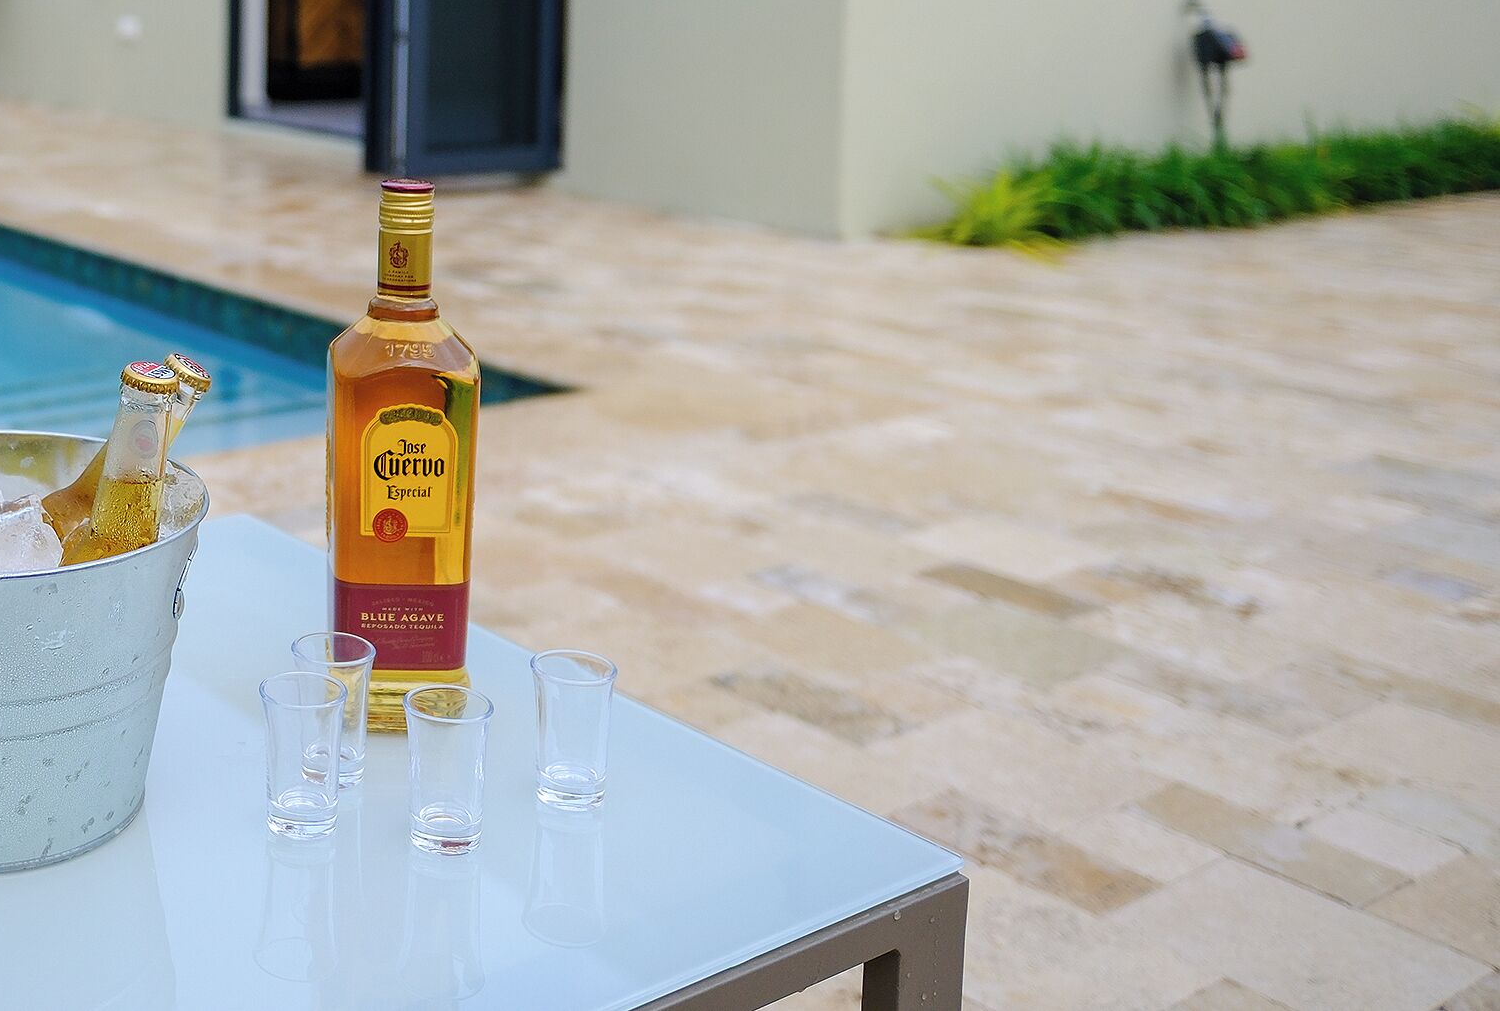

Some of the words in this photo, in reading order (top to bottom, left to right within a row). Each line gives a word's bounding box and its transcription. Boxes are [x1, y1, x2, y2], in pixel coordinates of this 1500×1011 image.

[384, 342, 436, 360] 1795
[397, 439, 427, 457] Jose
[373, 449, 445, 481] Cuervo
[386, 485, 431, 501] Especial
[361, 612, 396, 622] BLUE
[400, 613, 445, 622] AGAVE
